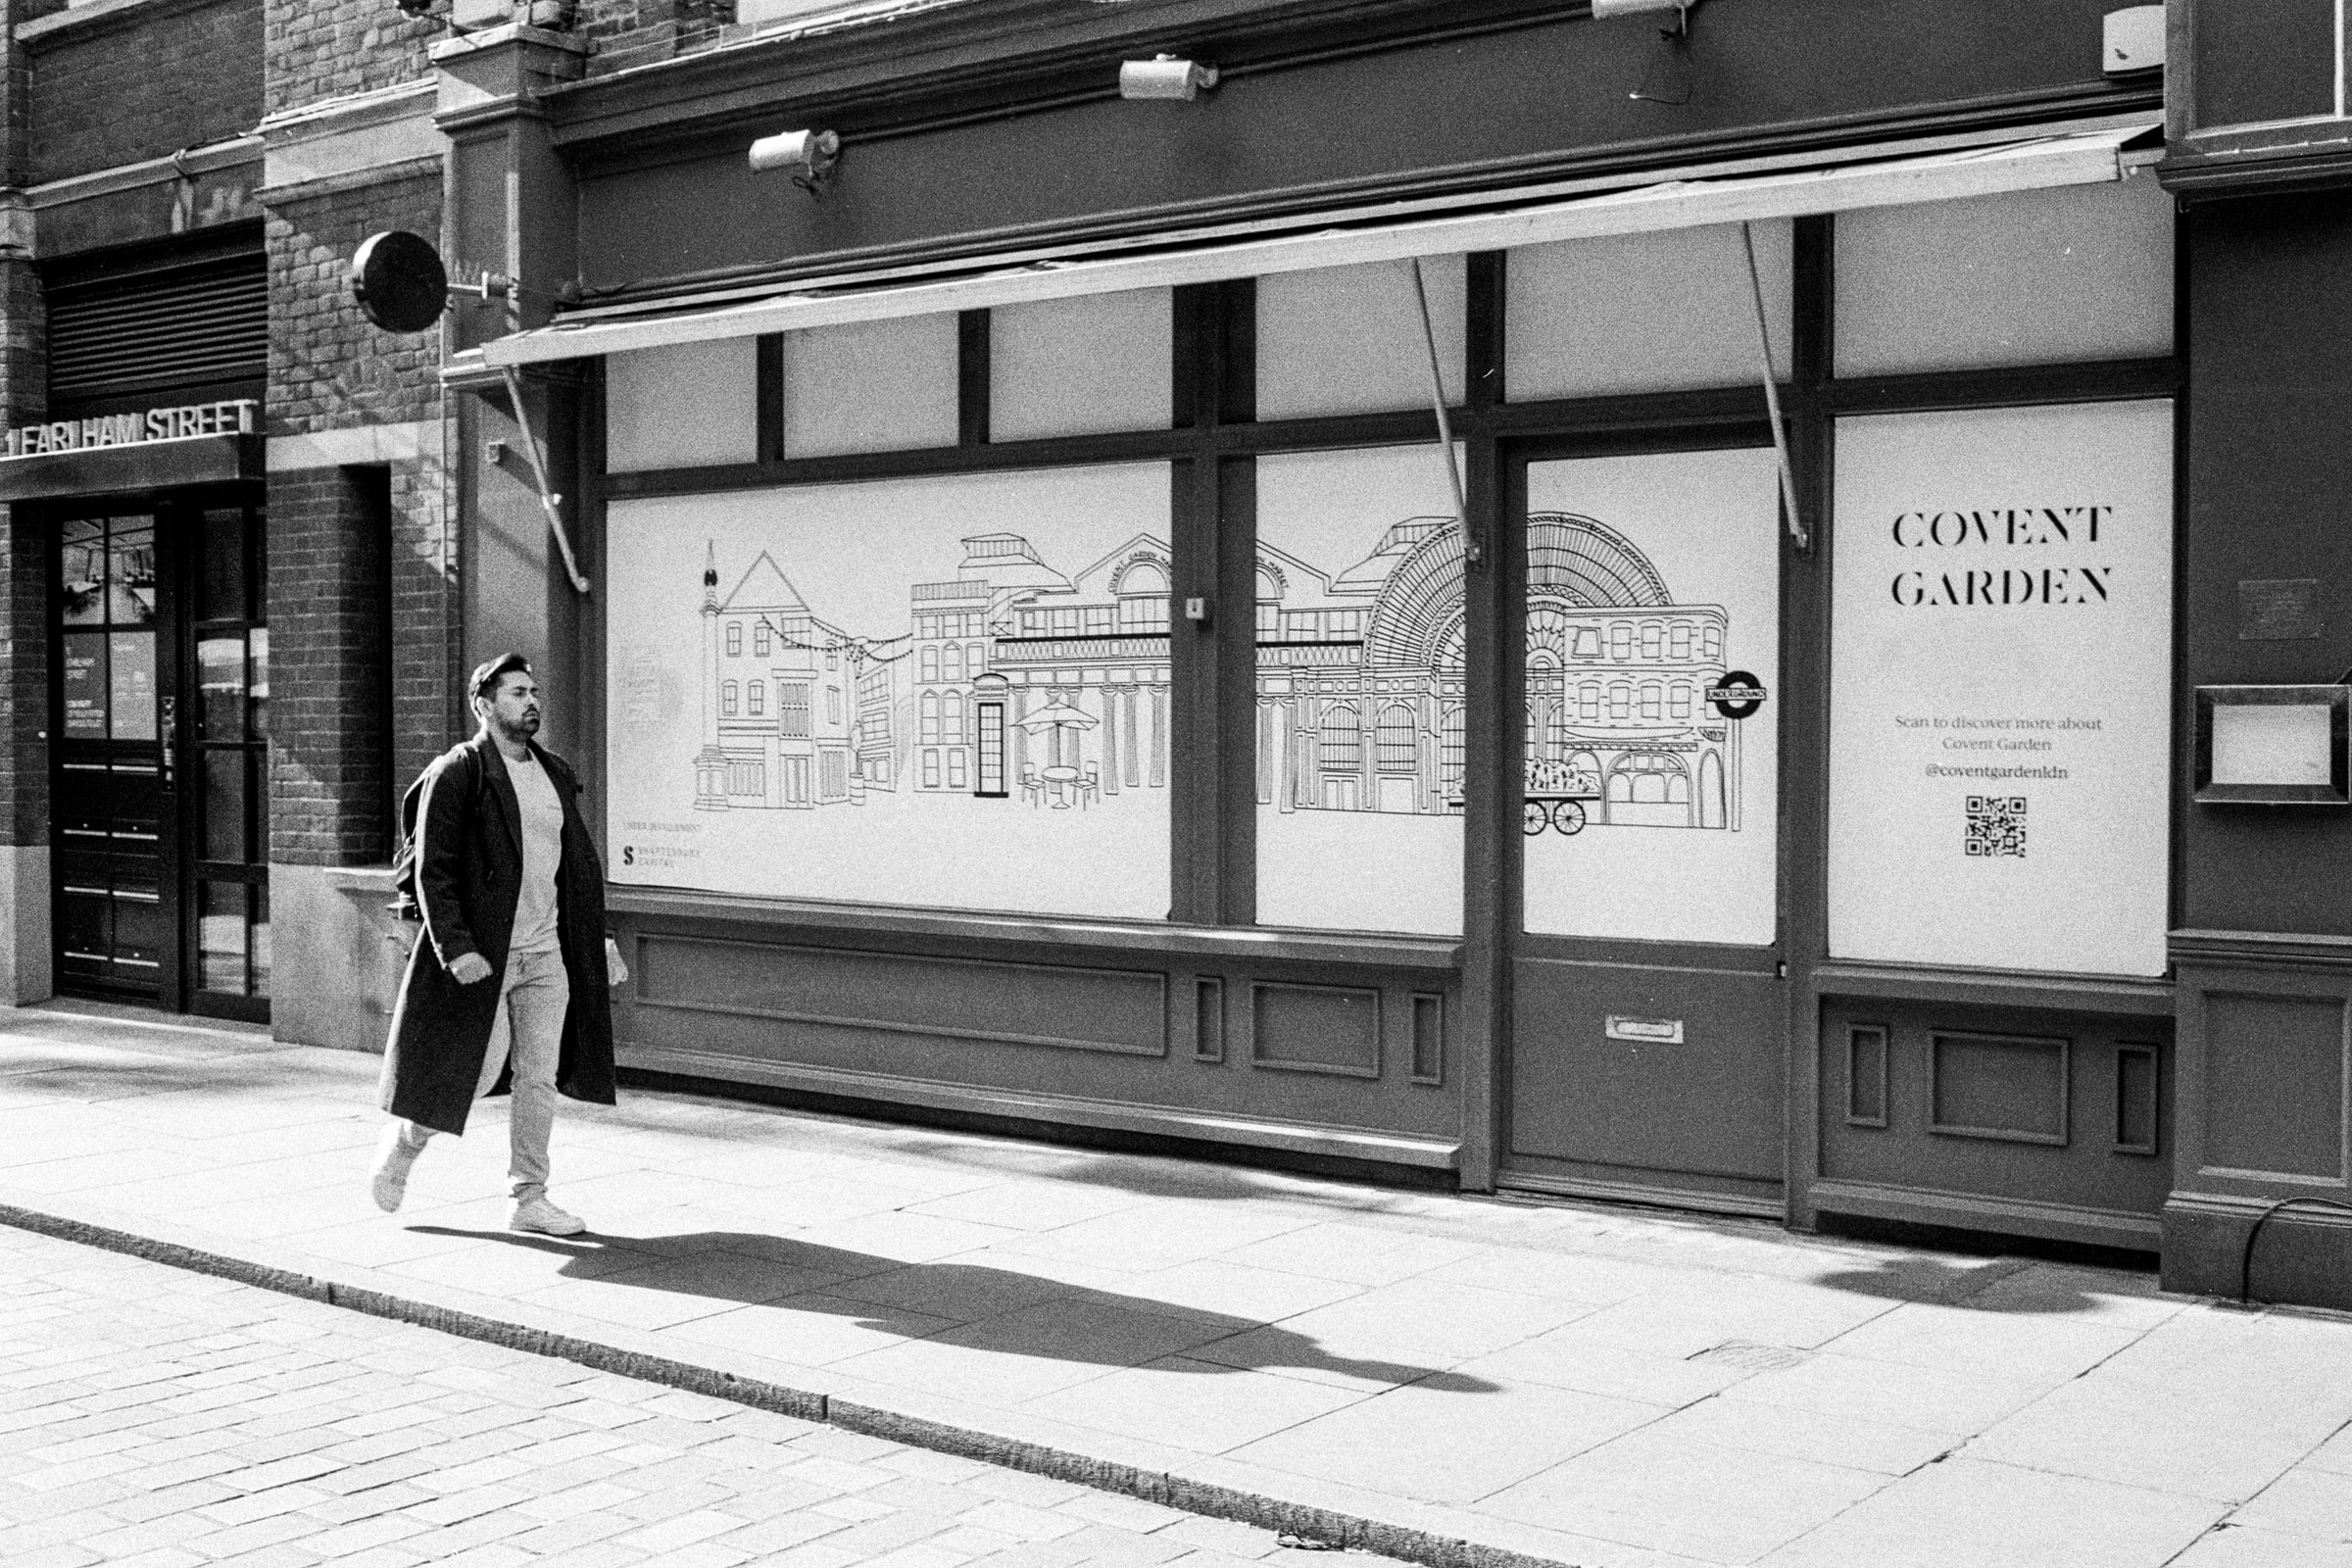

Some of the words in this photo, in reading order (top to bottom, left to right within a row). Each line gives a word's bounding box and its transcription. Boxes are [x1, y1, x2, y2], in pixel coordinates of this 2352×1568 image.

[5, 428, 21, 457] 1
[147, 399, 259, 441] STREET
[1892, 506, 2112, 547] COVENT
[1891, 567, 2111, 606] GARDEN
[1895, 715, 1930, 728] Scan
[1934, 716, 1948, 728] to
[1951, 716, 2010, 730] discover
[2015, 718, 2054, 730] more
[2058, 717, 2102, 731] about
[1942, 737, 1993, 751] Covent
[1996, 737, 2052, 752] Garden
[1926, 762, 2069, 780] @coventgardenldn
